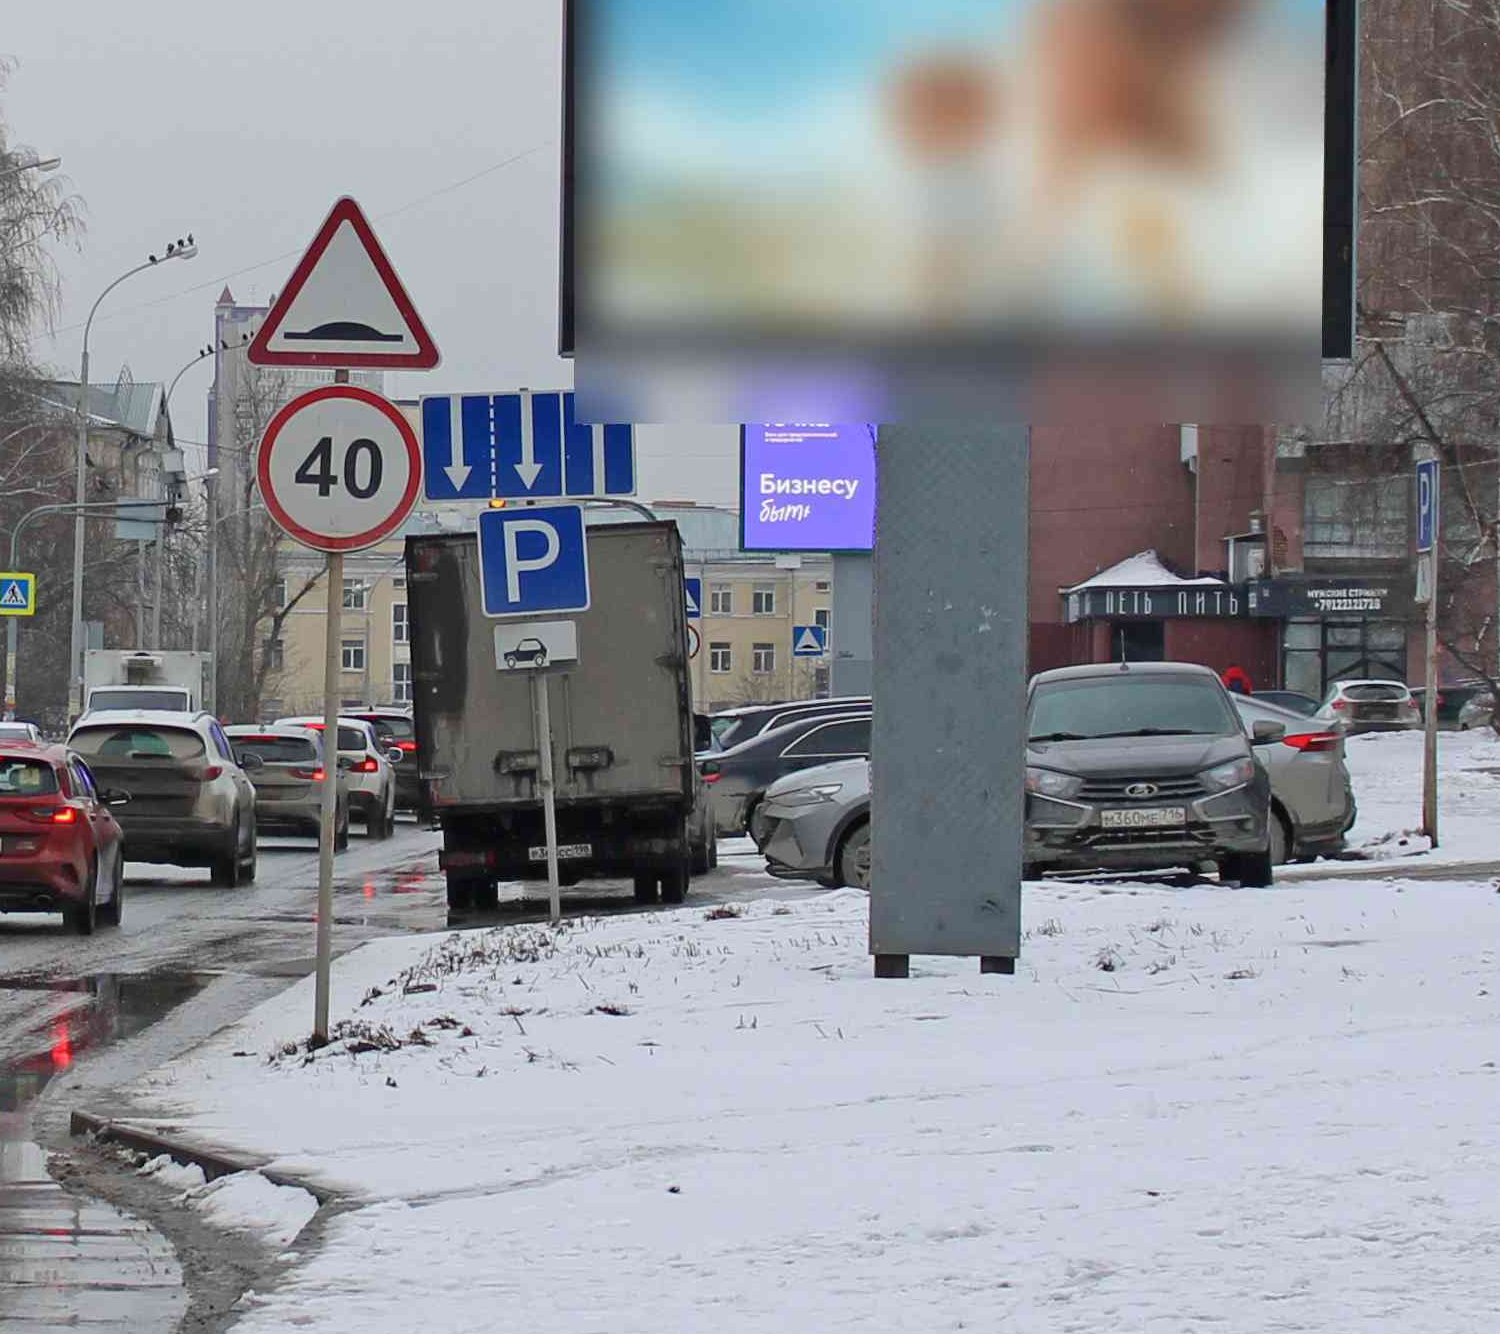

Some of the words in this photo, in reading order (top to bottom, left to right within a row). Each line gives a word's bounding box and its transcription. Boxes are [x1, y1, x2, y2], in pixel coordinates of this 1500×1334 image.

[295, 436, 384, 500] 40
[760, 472, 859, 500] Бизнесу
[1419, 471, 1430, 540] P
[503, 518, 561, 604] P
[1105, 590, 1152, 615] ПЕТЬ
[1177, 590, 1239, 615] ПИТЬ
